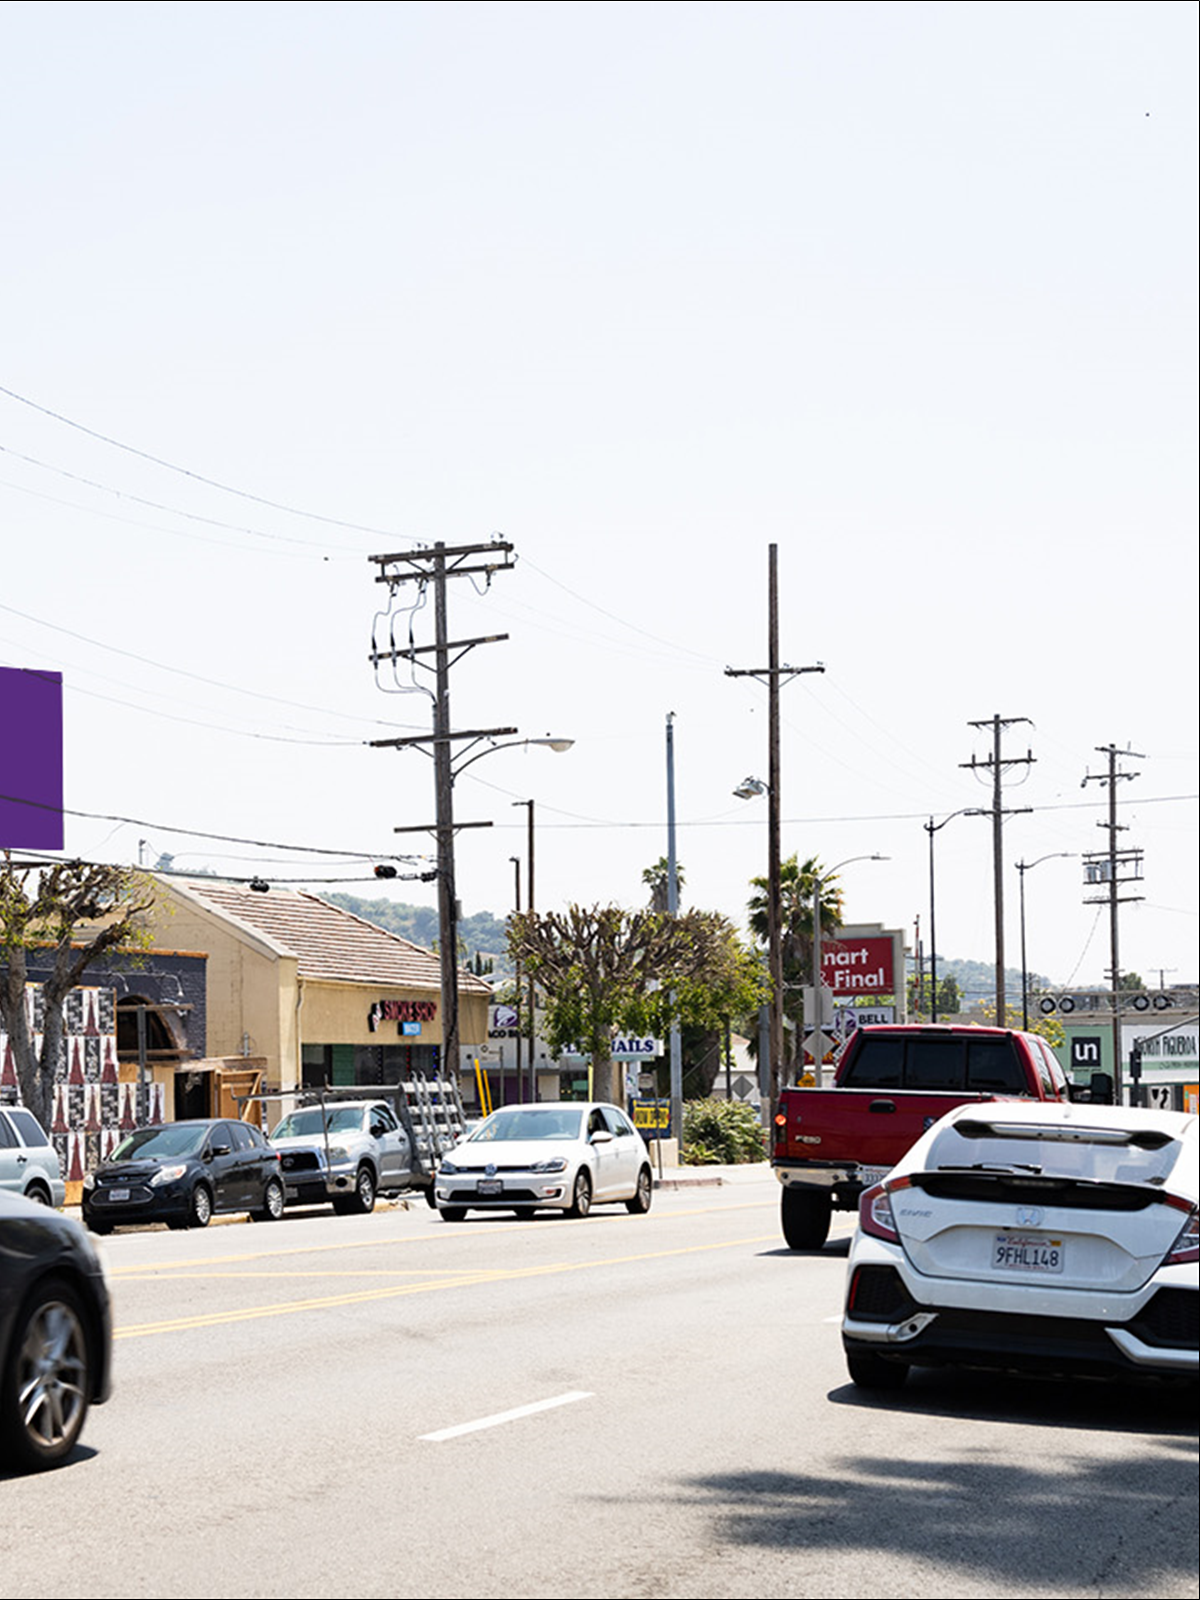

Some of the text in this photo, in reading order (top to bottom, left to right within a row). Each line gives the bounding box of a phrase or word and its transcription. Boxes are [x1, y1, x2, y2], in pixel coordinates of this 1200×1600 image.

[834, 968, 884, 988] Final
[384, 1001, 437, 1021] SMOKE SHOP
[859, 1014, 888, 1025] BELL
[611, 1039, 654, 1053] AILS
[900, 1209, 932, 1218] CIVIC
[996, 1247, 1059, 1267] 9FHL148
